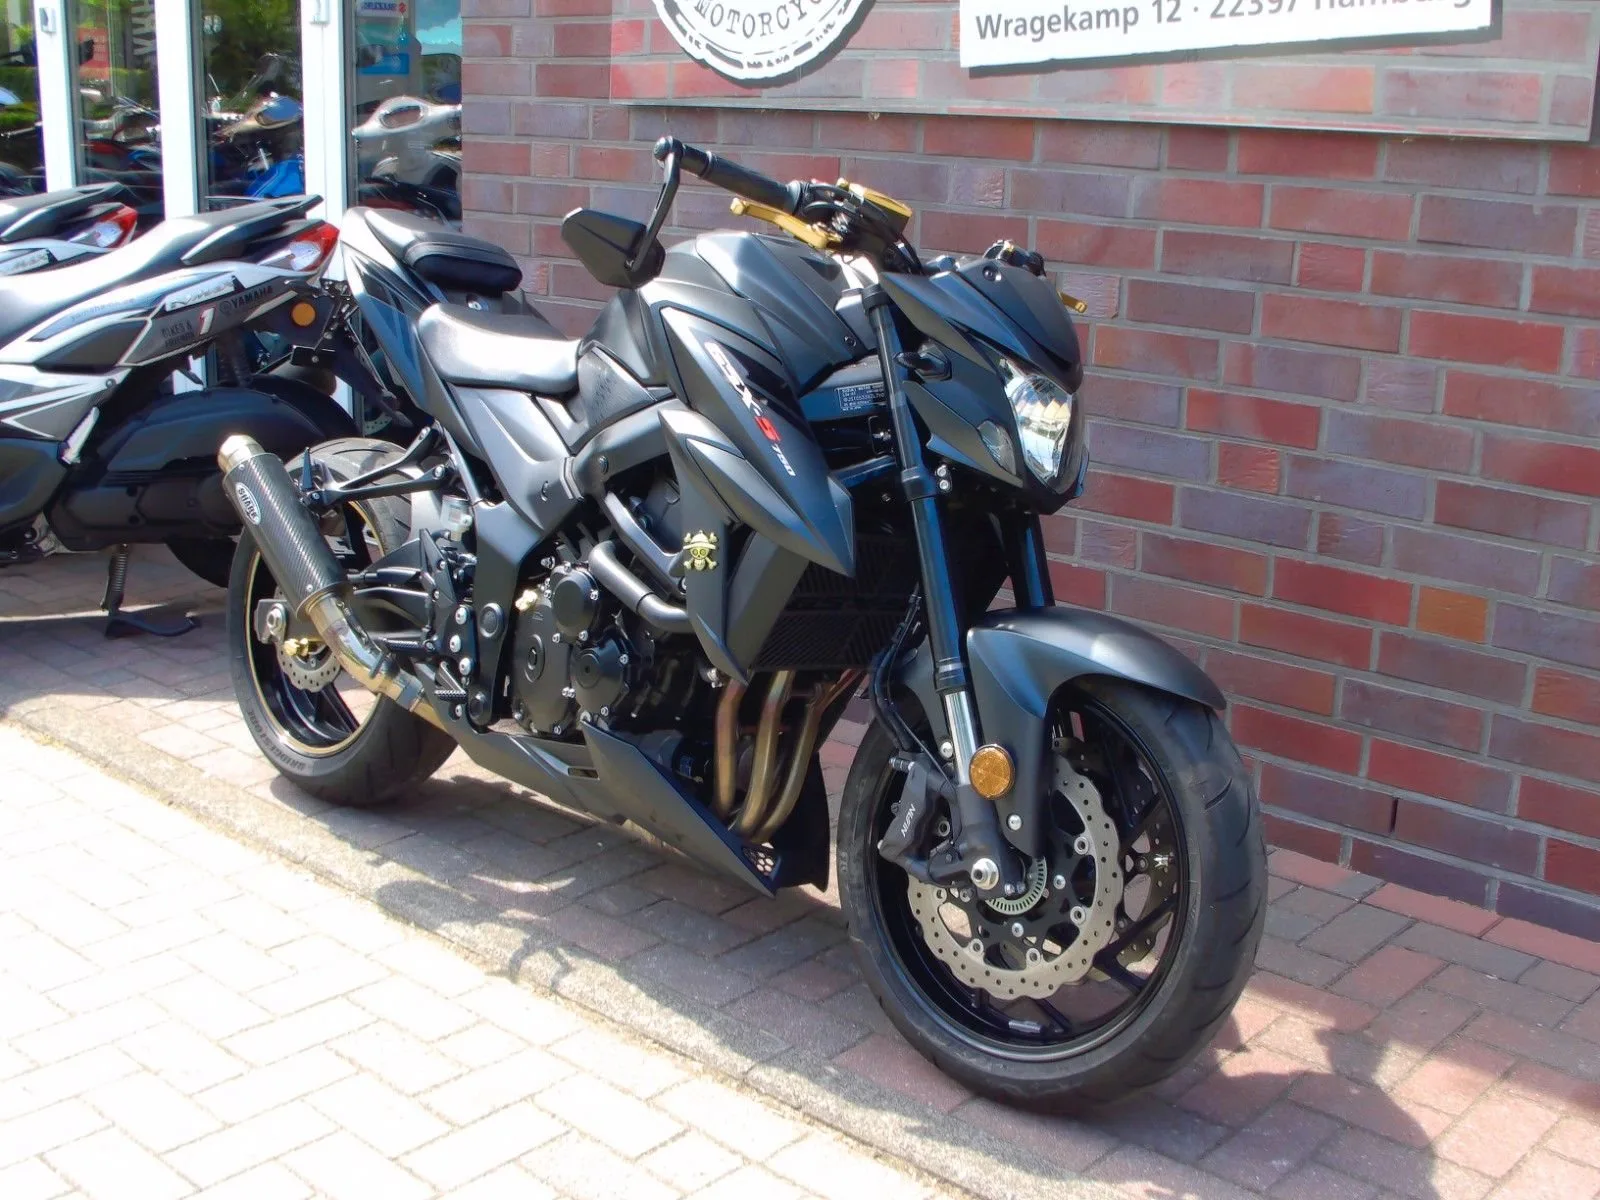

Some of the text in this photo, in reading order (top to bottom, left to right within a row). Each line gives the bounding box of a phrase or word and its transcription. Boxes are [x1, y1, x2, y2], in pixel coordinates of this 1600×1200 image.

[976, 5, 1139, 42] Wragekamp
[1151, 0, 1182, 23] 12
[230, 284, 274, 309] YAMAHA
